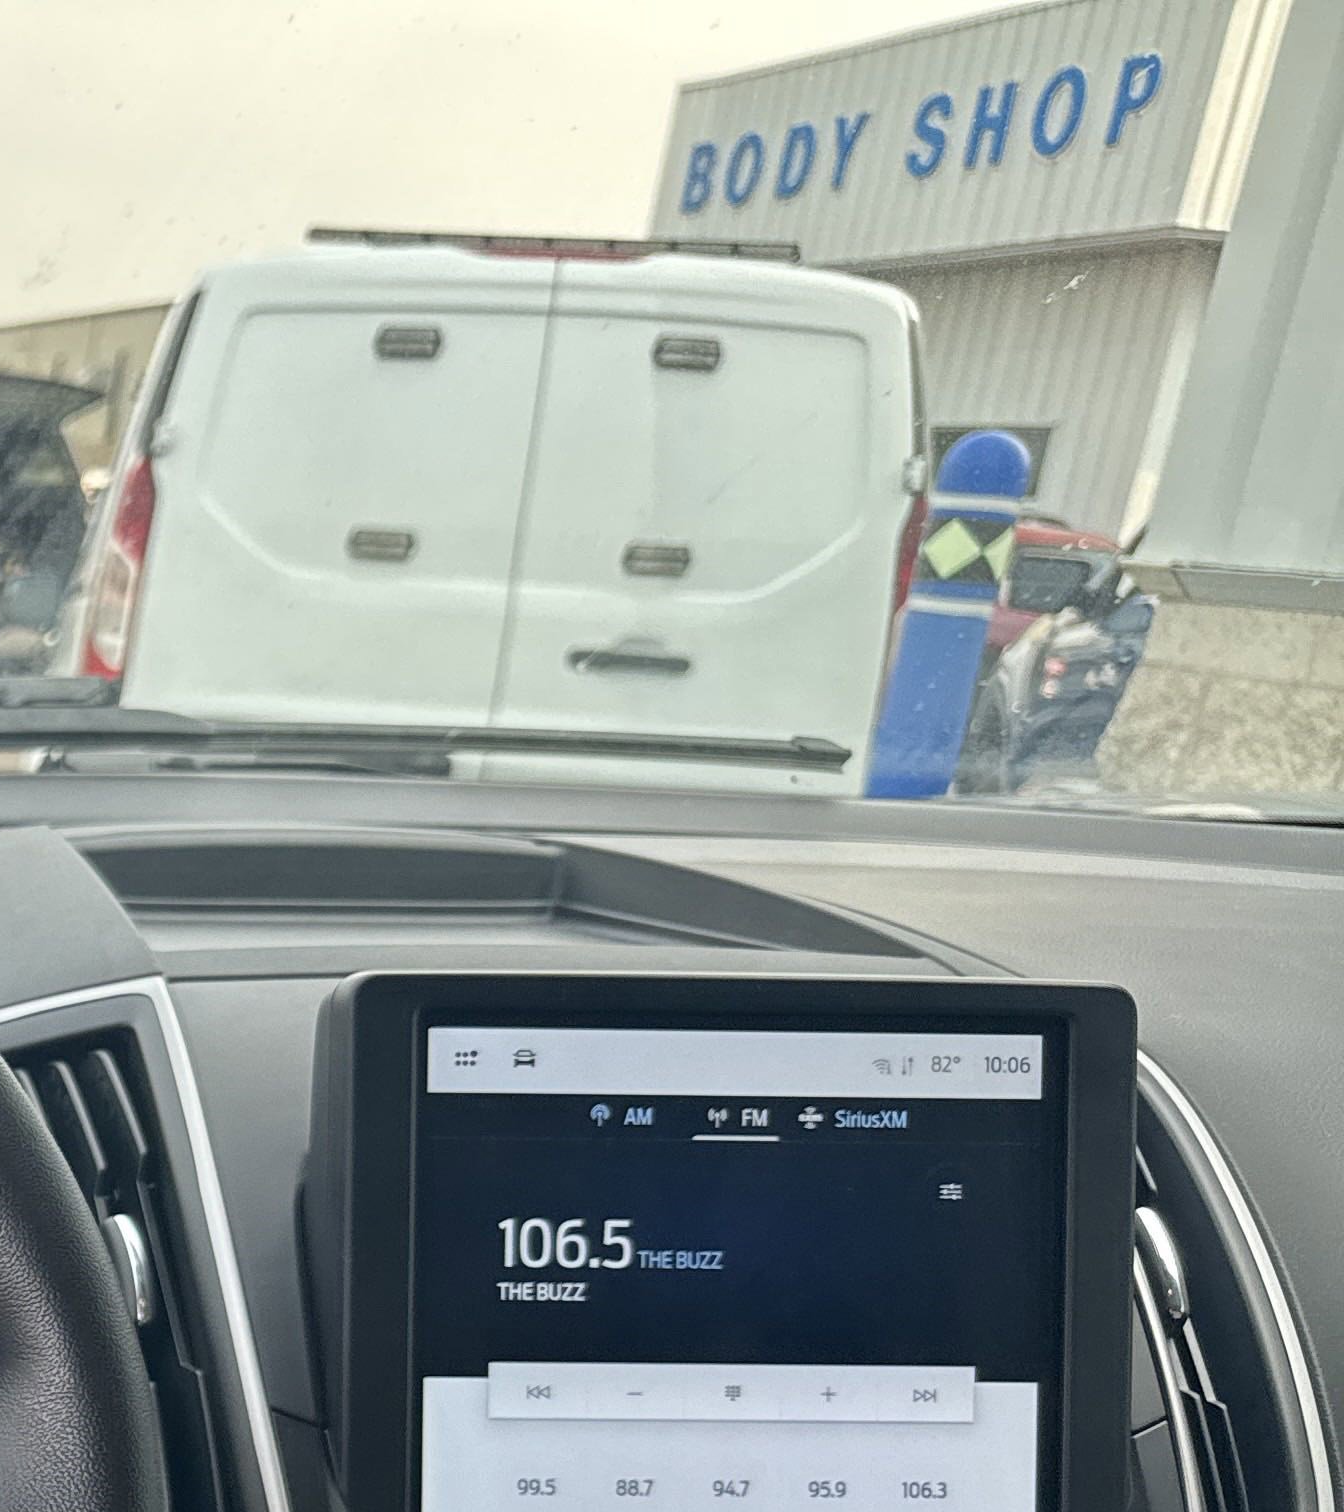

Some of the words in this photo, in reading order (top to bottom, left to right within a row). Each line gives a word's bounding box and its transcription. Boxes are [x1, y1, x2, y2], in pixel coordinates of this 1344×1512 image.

[680, 112, 871, 215] BODY
[905, 53, 1163, 179] SHOP
[930, 1055, 962, 1074] 82°
[983, 1056, 1031, 1074] 10:06
[622, 1107, 653, 1126] AM
[740, 1108, 768, 1127] FM
[833, 1109, 907, 1130] SiriusXM
[496, 1217, 633, 1269] 106.5
[637, 1250, 674, 1270] THE
[676, 1250, 723, 1270] BUZZ
[496, 1282, 535, 1302] THE
[537, 1282, 587, 1302] BUZZ
[516, 1477, 556, 1497] 99.5
[615, 1479, 653, 1497] 88.7
[712, 1479, 750, 1498] 94.7
[808, 1480, 847, 1500] 95.9
[900, 1481, 947, 1500] 106.3
